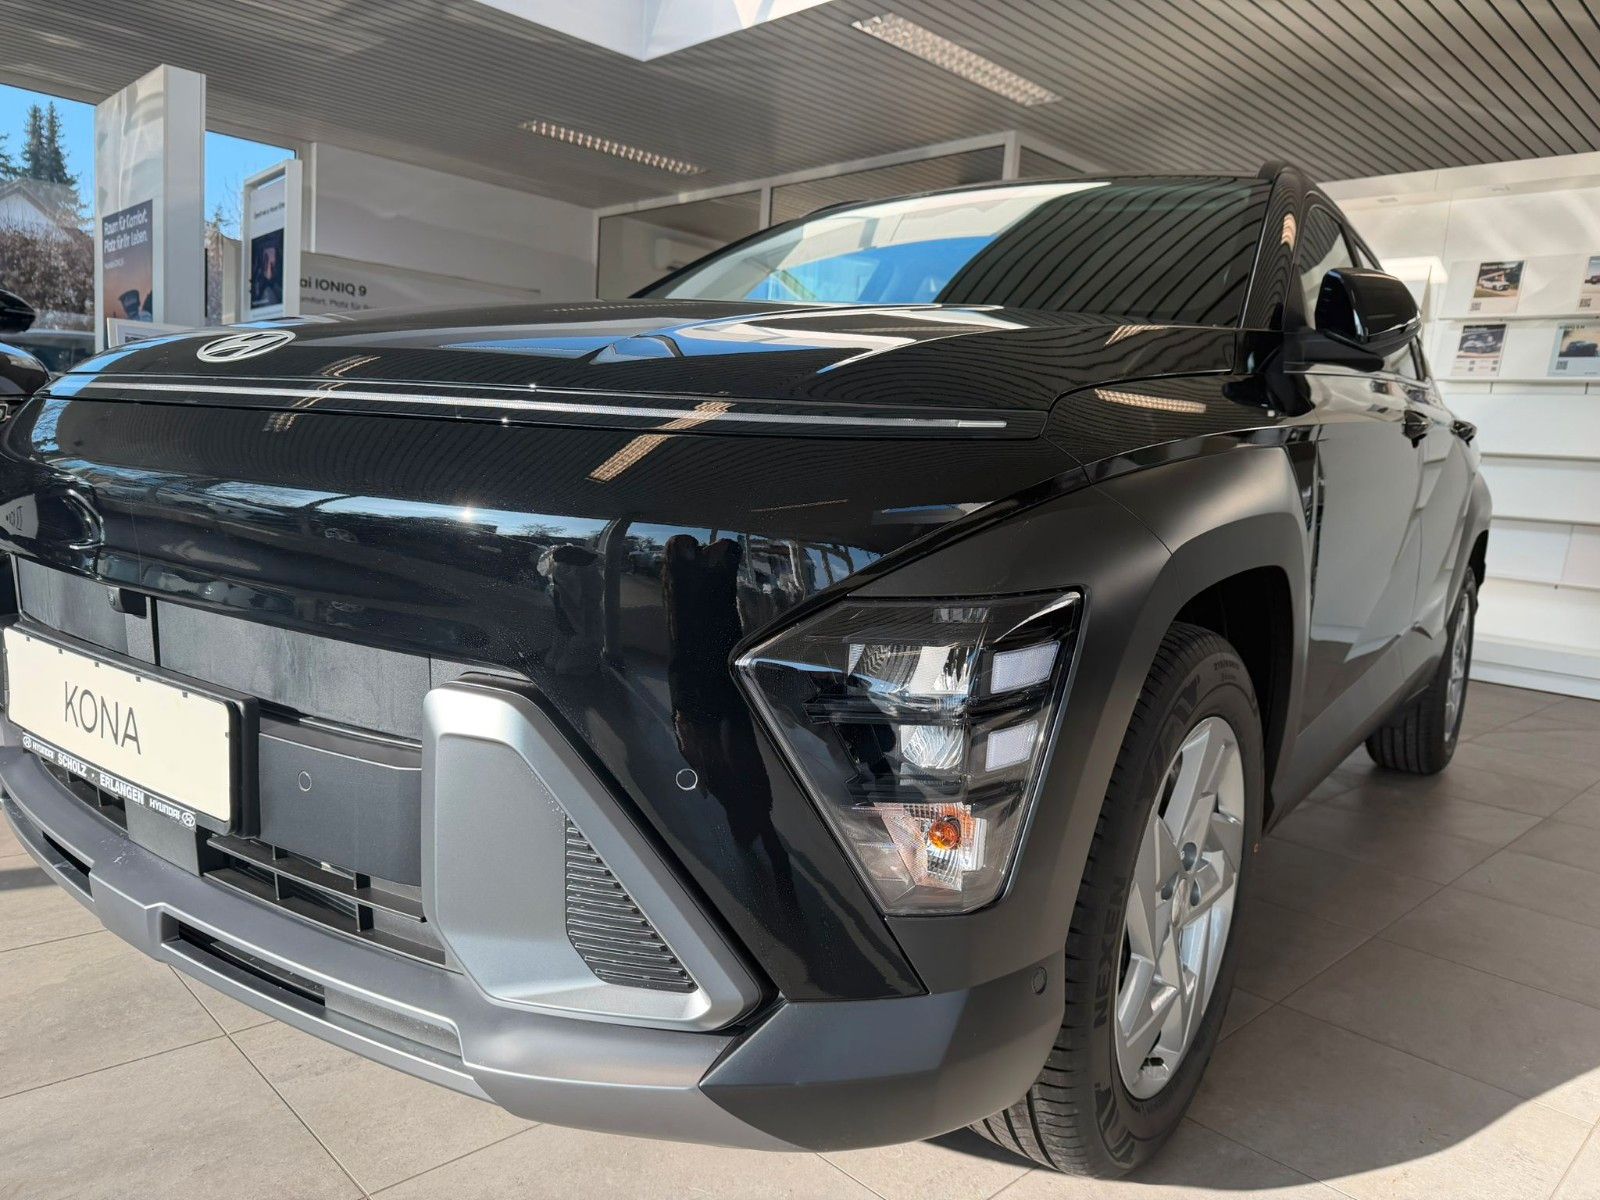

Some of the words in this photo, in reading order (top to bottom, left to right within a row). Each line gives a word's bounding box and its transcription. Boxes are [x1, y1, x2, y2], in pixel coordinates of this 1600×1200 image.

[315, 277, 356, 296] IONIQ
[358, 284, 367, 296] 9
[64, 681, 141, 755] KONA
[58, 753, 87, 777] SCHOLZ
[100, 774, 145, 805] ERLANGEN
[149, 798, 181, 820] HYUNDAI
